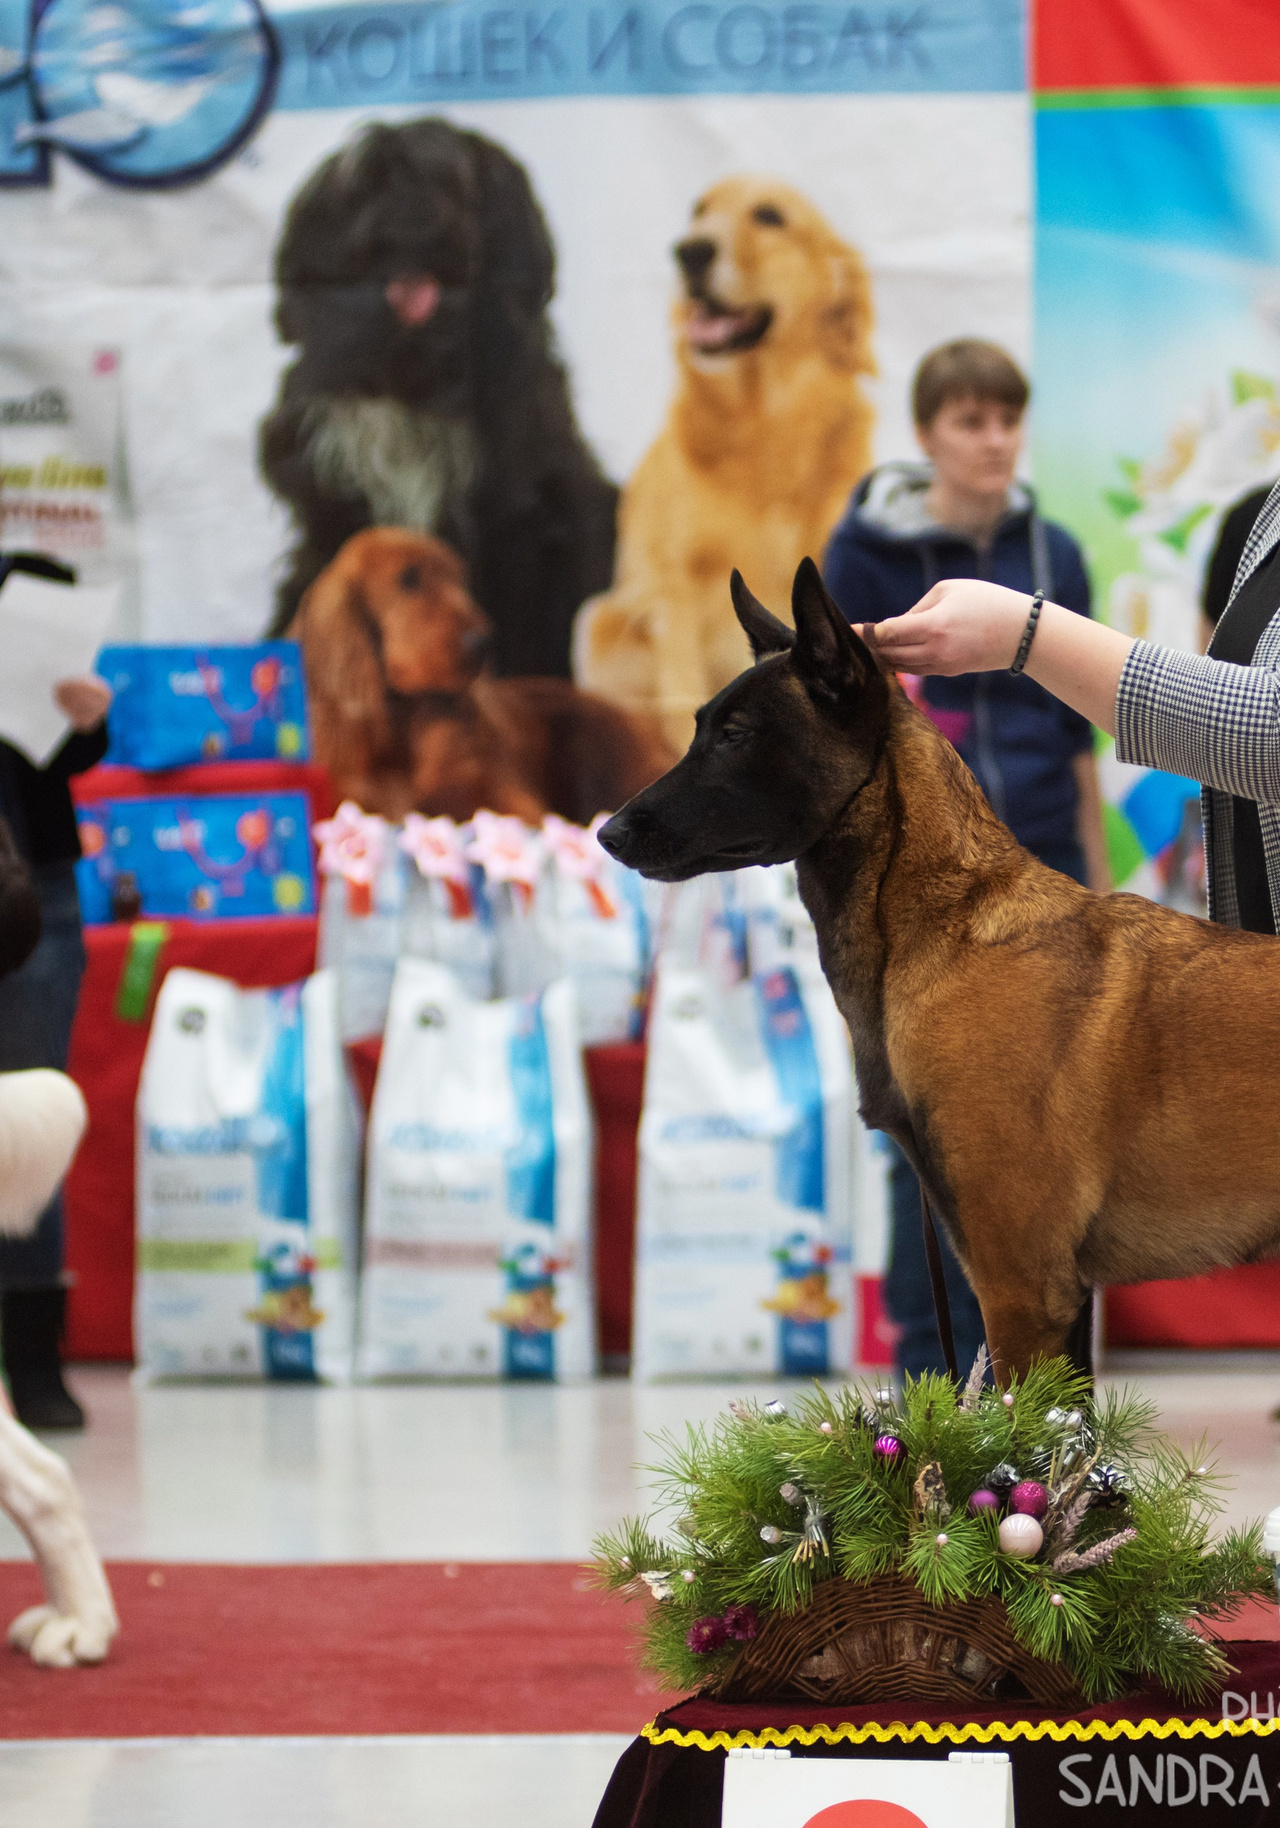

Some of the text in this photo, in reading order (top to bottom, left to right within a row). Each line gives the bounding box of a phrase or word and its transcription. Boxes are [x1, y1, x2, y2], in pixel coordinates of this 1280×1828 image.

[302, 3, 937, 94] КОШЕК И СОБАК
